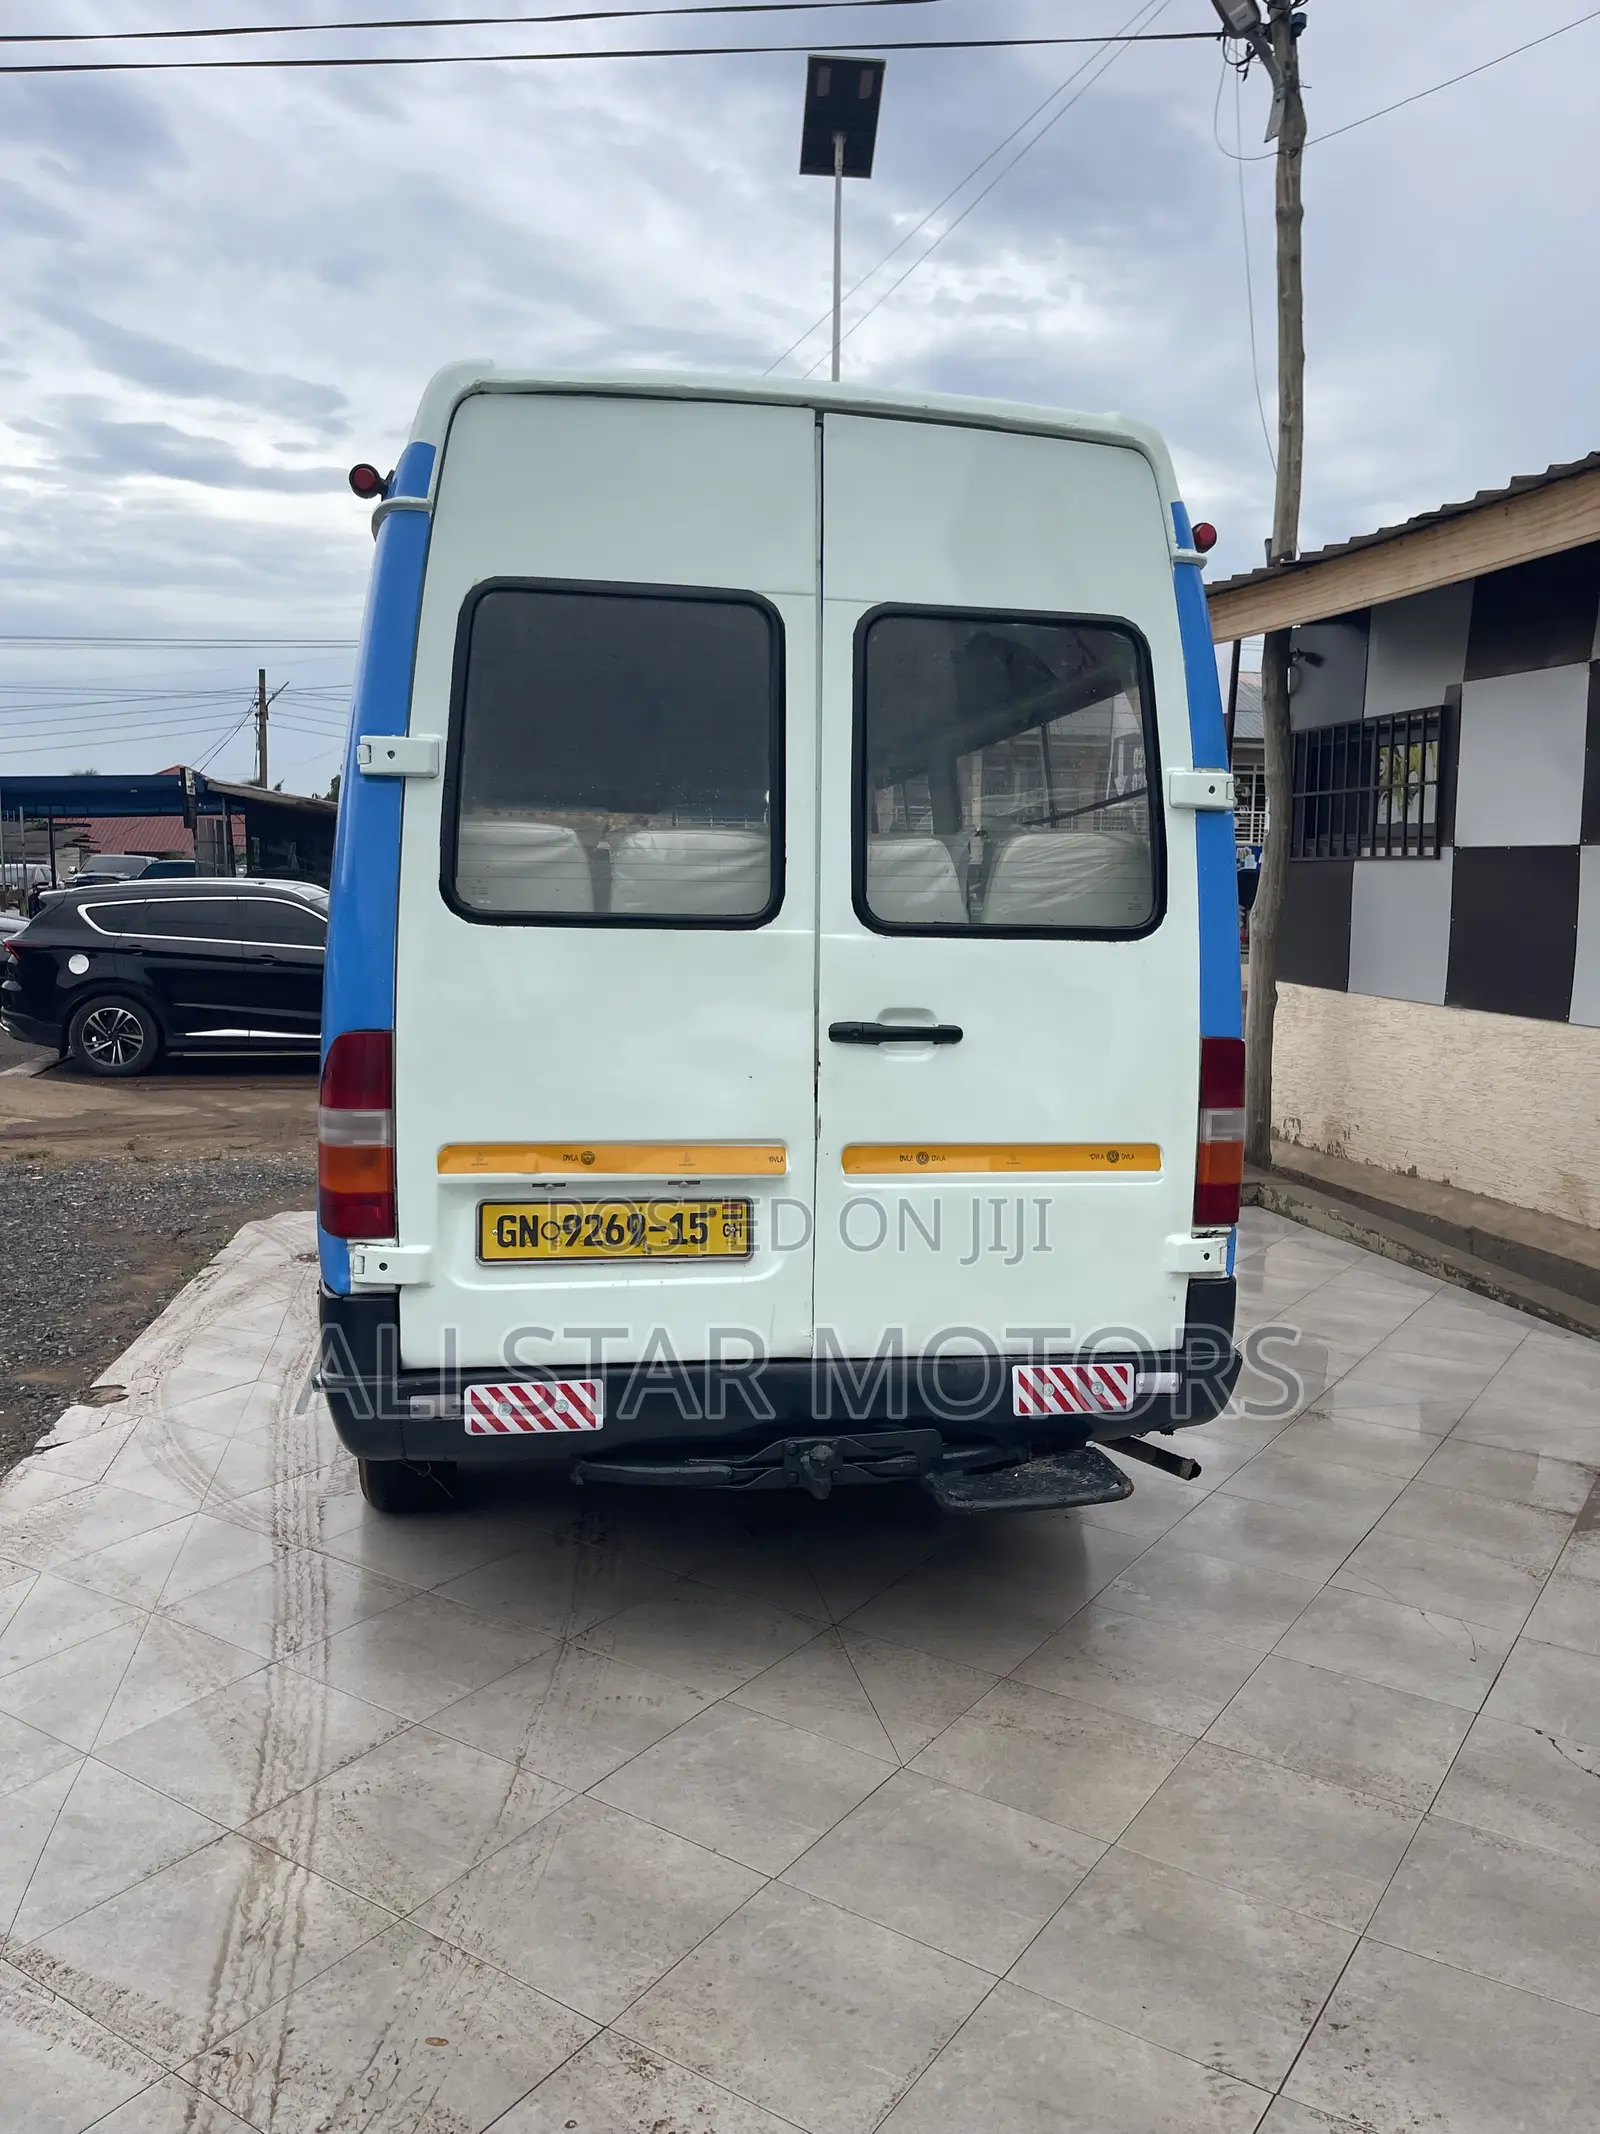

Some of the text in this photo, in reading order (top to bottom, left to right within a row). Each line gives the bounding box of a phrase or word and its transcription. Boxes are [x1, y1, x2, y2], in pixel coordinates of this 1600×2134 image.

[562, 1153, 579, 1162] DVLA
[496, 1212, 709, 1248] GN 9269-15
